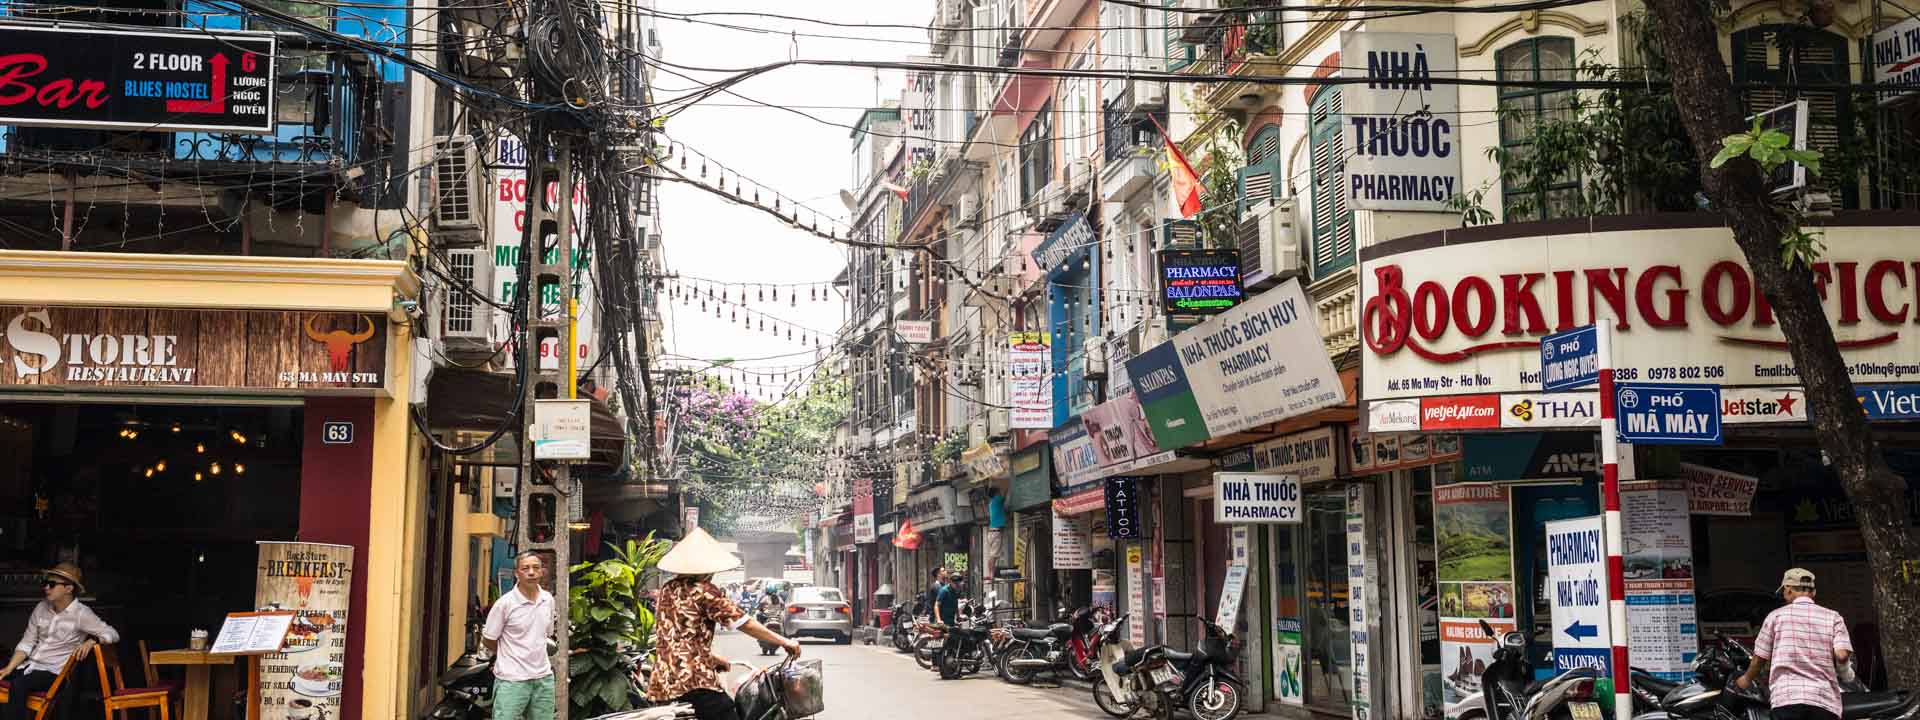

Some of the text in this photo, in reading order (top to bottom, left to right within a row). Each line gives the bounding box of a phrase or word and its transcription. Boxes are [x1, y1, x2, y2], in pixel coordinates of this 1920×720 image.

[133, 53, 202, 71] 2 FLOOR
[242, 52, 256, 72] 6
[1368, 43, 1432, 91] NHÀ
[125, 80, 209, 99] BLUES HOSTEL
[1352, 105, 1450, 158] THUỐC
[1352, 174, 1455, 201] PHARMACY
[1167, 266, 1237, 278] PHARMACY
[1167, 285, 1237, 298] SALONPAS
[1363, 264, 1690, 355] BOOKING
[1182, 297, 1298, 367] NHÀ THUỐC BÍCH HUY
[2, 308, 177, 379] STORE
[1560, 335, 1580, 354] PHỐ
[1220, 343, 1272, 376] PHARMACY
[67, 366, 196, 383] RESTAURANT
[279, 371, 378, 384] 63 MA MAY STR
[1139, 365, 1177, 393] SALONPAS
[1402, 379, 1410, 390] 65
[1411, 378, 1421, 390] Ma
[1423, 377, 1439, 390] May
[1440, 376, 1453, 388] Str
[1460, 374, 1472, 387] Ha
[1648, 366, 1676, 380] 0978
[1680, 365, 1700, 379] 802
[1704, 365, 1724, 379] 506
[1651, 391, 1684, 407] PHỐ
[1721, 398, 1778, 416] Jetstar
[1537, 401, 1594, 419] THAI
[1627, 409, 1709, 433] MÃ MÂY
[328, 426, 348, 441] 63
[1470, 466, 1492, 477] ATM
[1542, 453, 1594, 473] ANZ
[1223, 475, 1297, 501] NHÀ THUỐC
[1115, 480, 1130, 536] TATTOO
[1225, 506, 1296, 519] PHARMACY
[1550, 529, 1600, 566] PHARMACY
[1557, 568, 1599, 607] NHÀ THUỐC
[1558, 653, 1605, 671] SALONPAS
